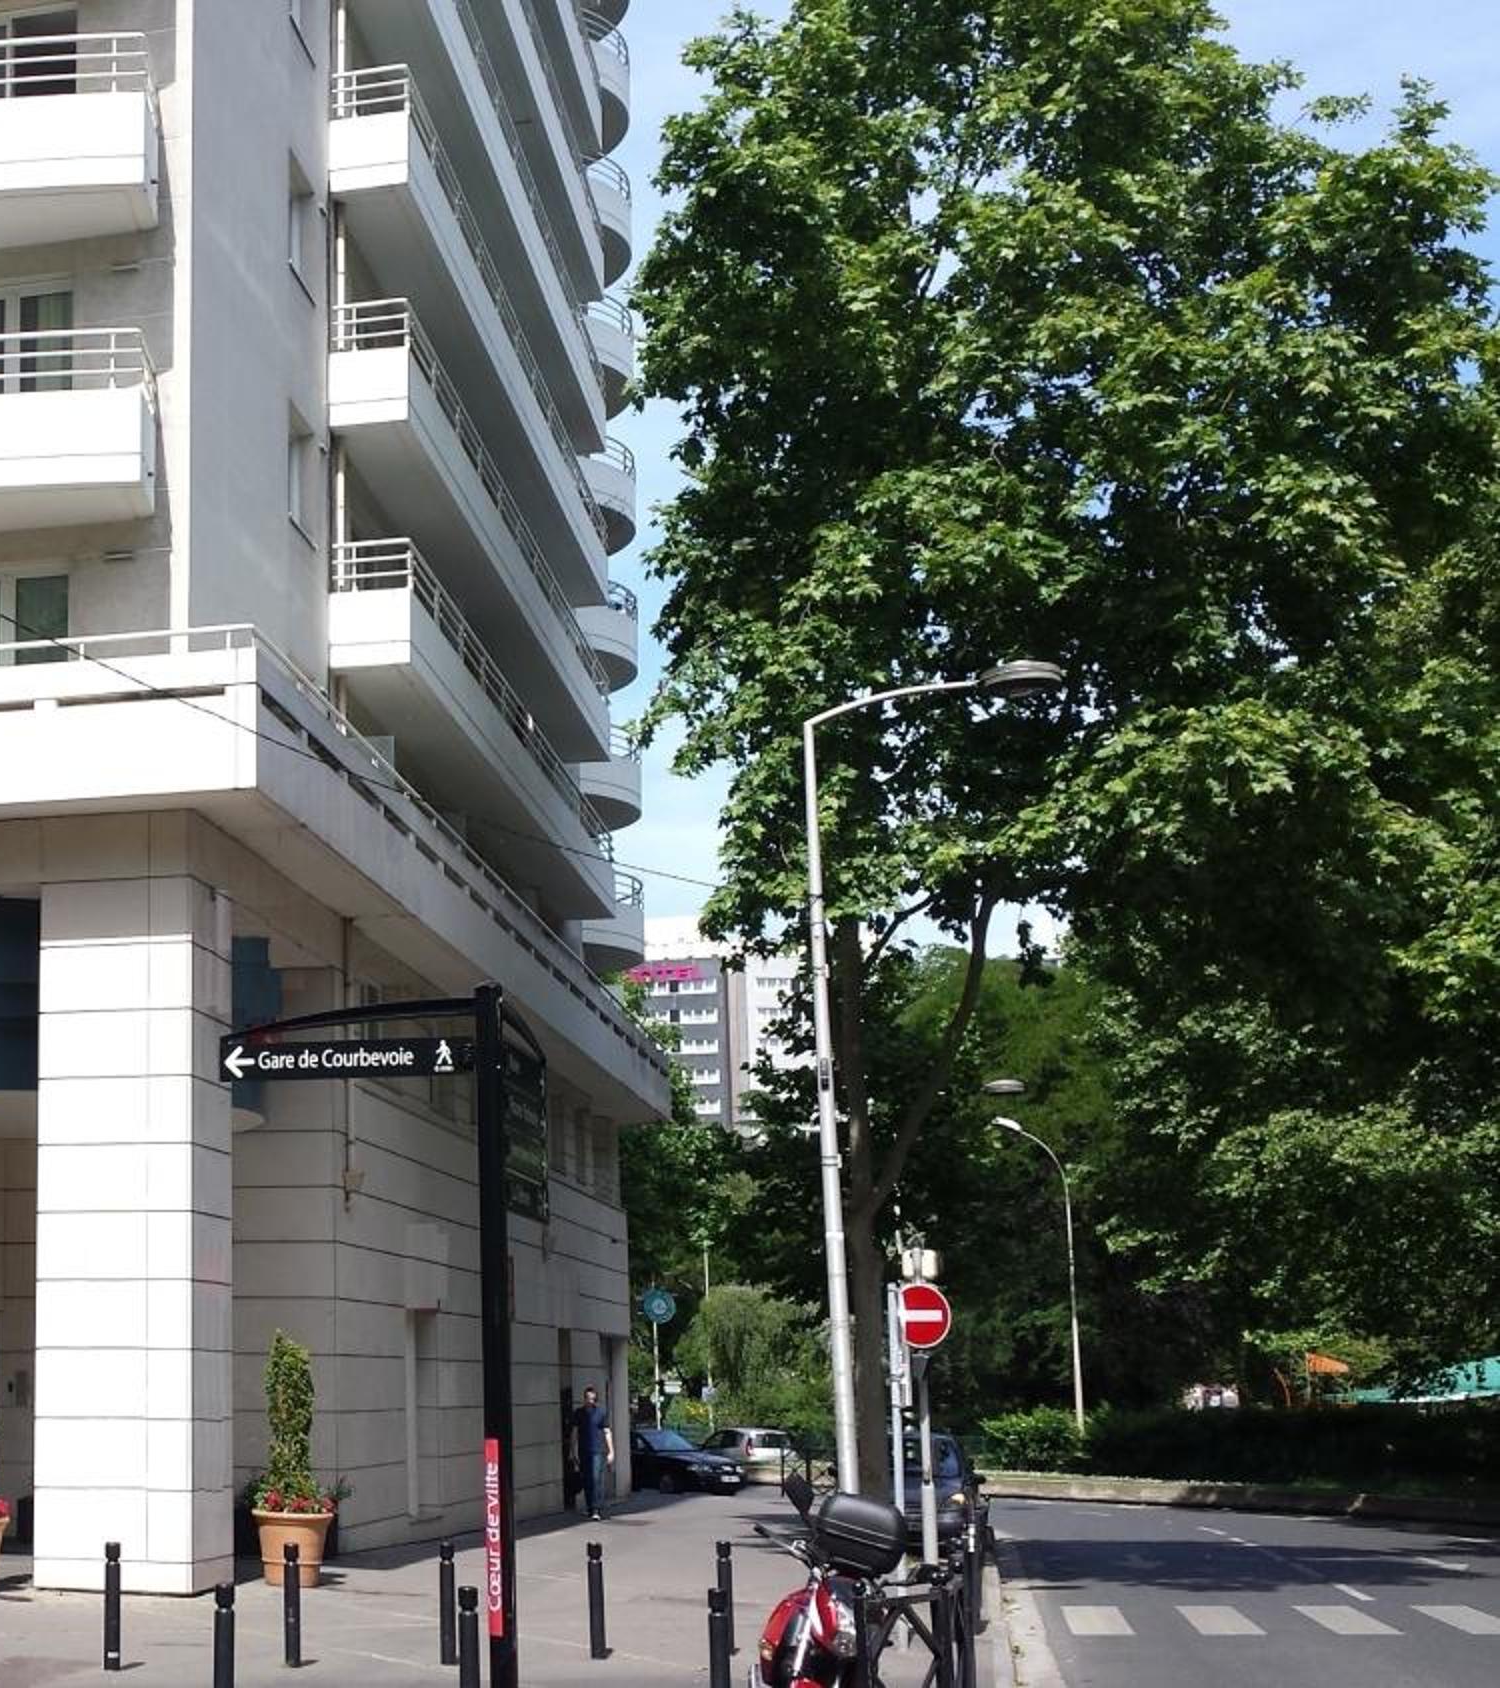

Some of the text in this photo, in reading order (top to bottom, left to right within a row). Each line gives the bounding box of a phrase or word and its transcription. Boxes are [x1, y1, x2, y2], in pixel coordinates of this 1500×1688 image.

[258, 1047, 414, 1069] Gare de Courbevoie
[485, 1462, 502, 1611] Cœur de ville
